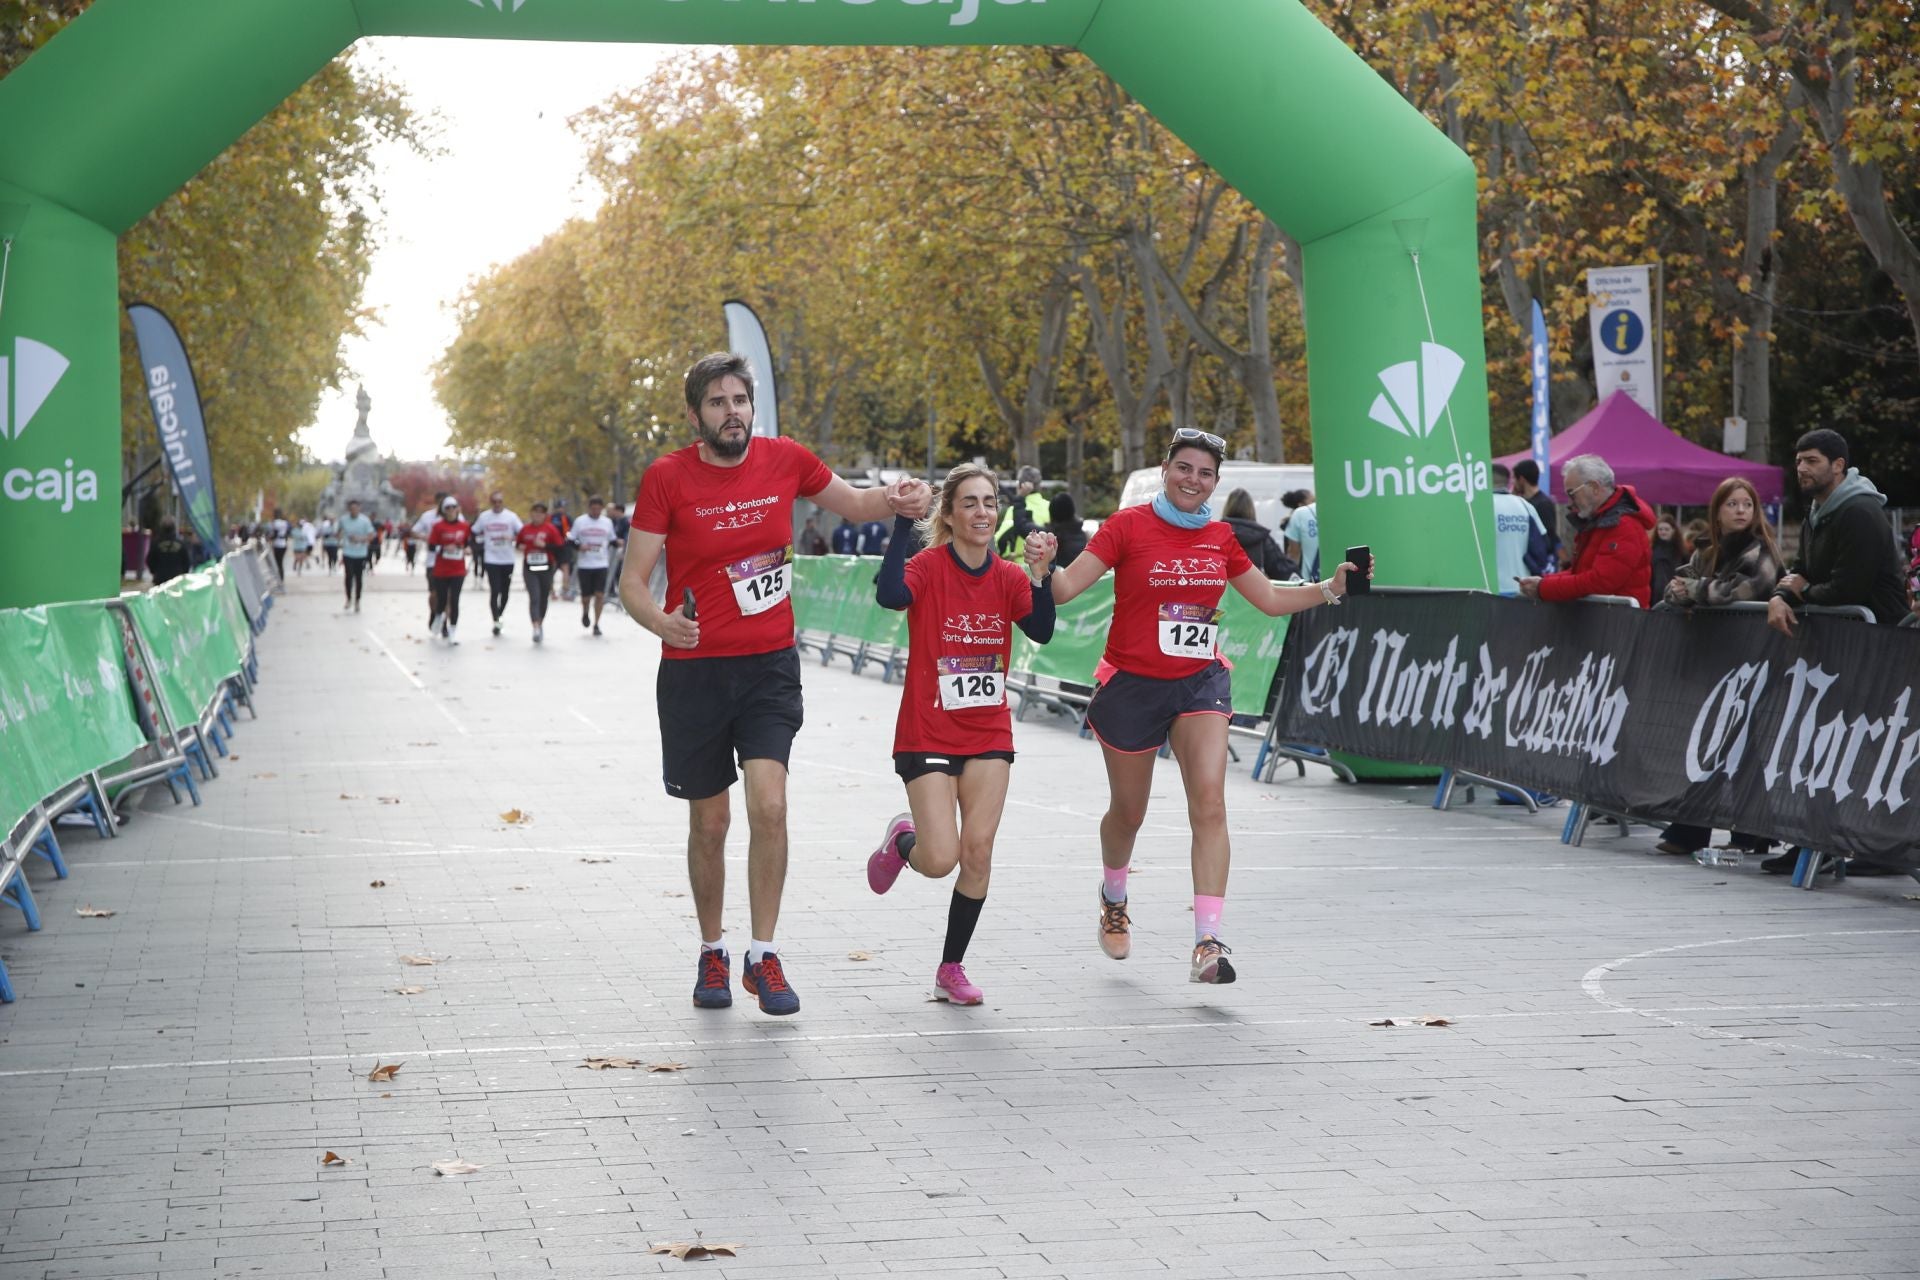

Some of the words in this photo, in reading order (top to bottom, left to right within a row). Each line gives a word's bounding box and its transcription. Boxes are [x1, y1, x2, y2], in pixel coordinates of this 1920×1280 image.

[3, 458, 97, 513] caja
[1345, 452, 1488, 503] Unicaja
[695, 505, 725, 517] Sports
[737, 495, 779, 510] Santander
[1498, 523, 1527, 534] Group
[747, 570, 783, 602] 125
[1149, 578, 1176, 587] Sports
[942, 631, 961, 642] Sprts
[1170, 624, 1209, 648] 124
[1302, 626, 1358, 717] El
[952, 675, 996, 697] 126
[1686, 659, 1769, 782] El
[1764, 657, 1920, 814] Norte
